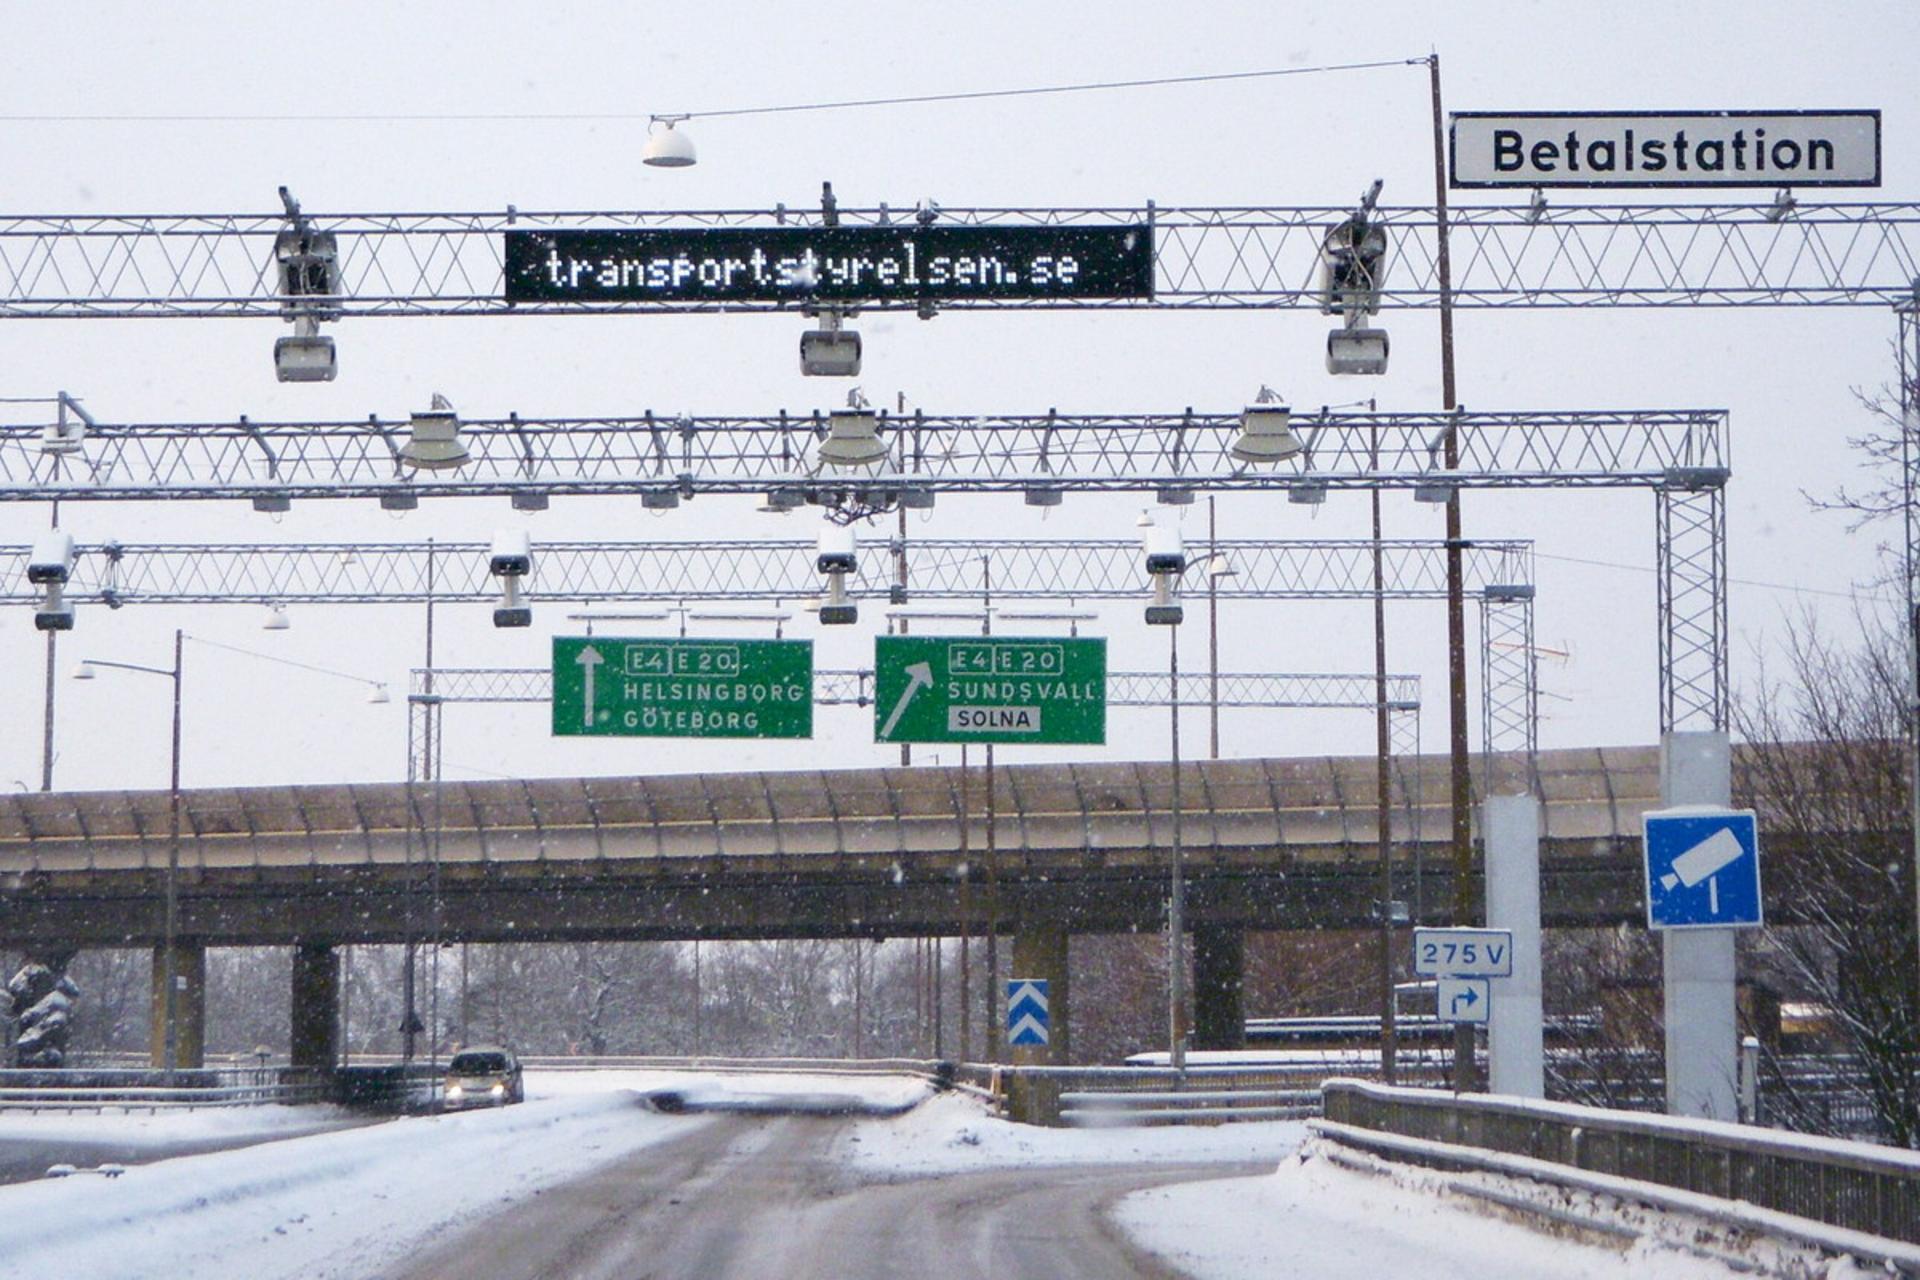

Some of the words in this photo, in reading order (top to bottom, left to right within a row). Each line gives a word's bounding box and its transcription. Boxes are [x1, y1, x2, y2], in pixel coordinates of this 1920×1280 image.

[1493, 127, 1835, 172] Betalstation
[545, 241, 1081, 288] transportstyrelsen.se
[624, 683, 804, 702] HELSINGBORG
[949, 682, 1096, 700] SUNDSVALL
[624, 707, 759, 729] GÖTEBORG
[957, 710, 1031, 728] SOLNA
[1422, 943, 1477, 964] 275
[1486, 943, 1504, 965] V
